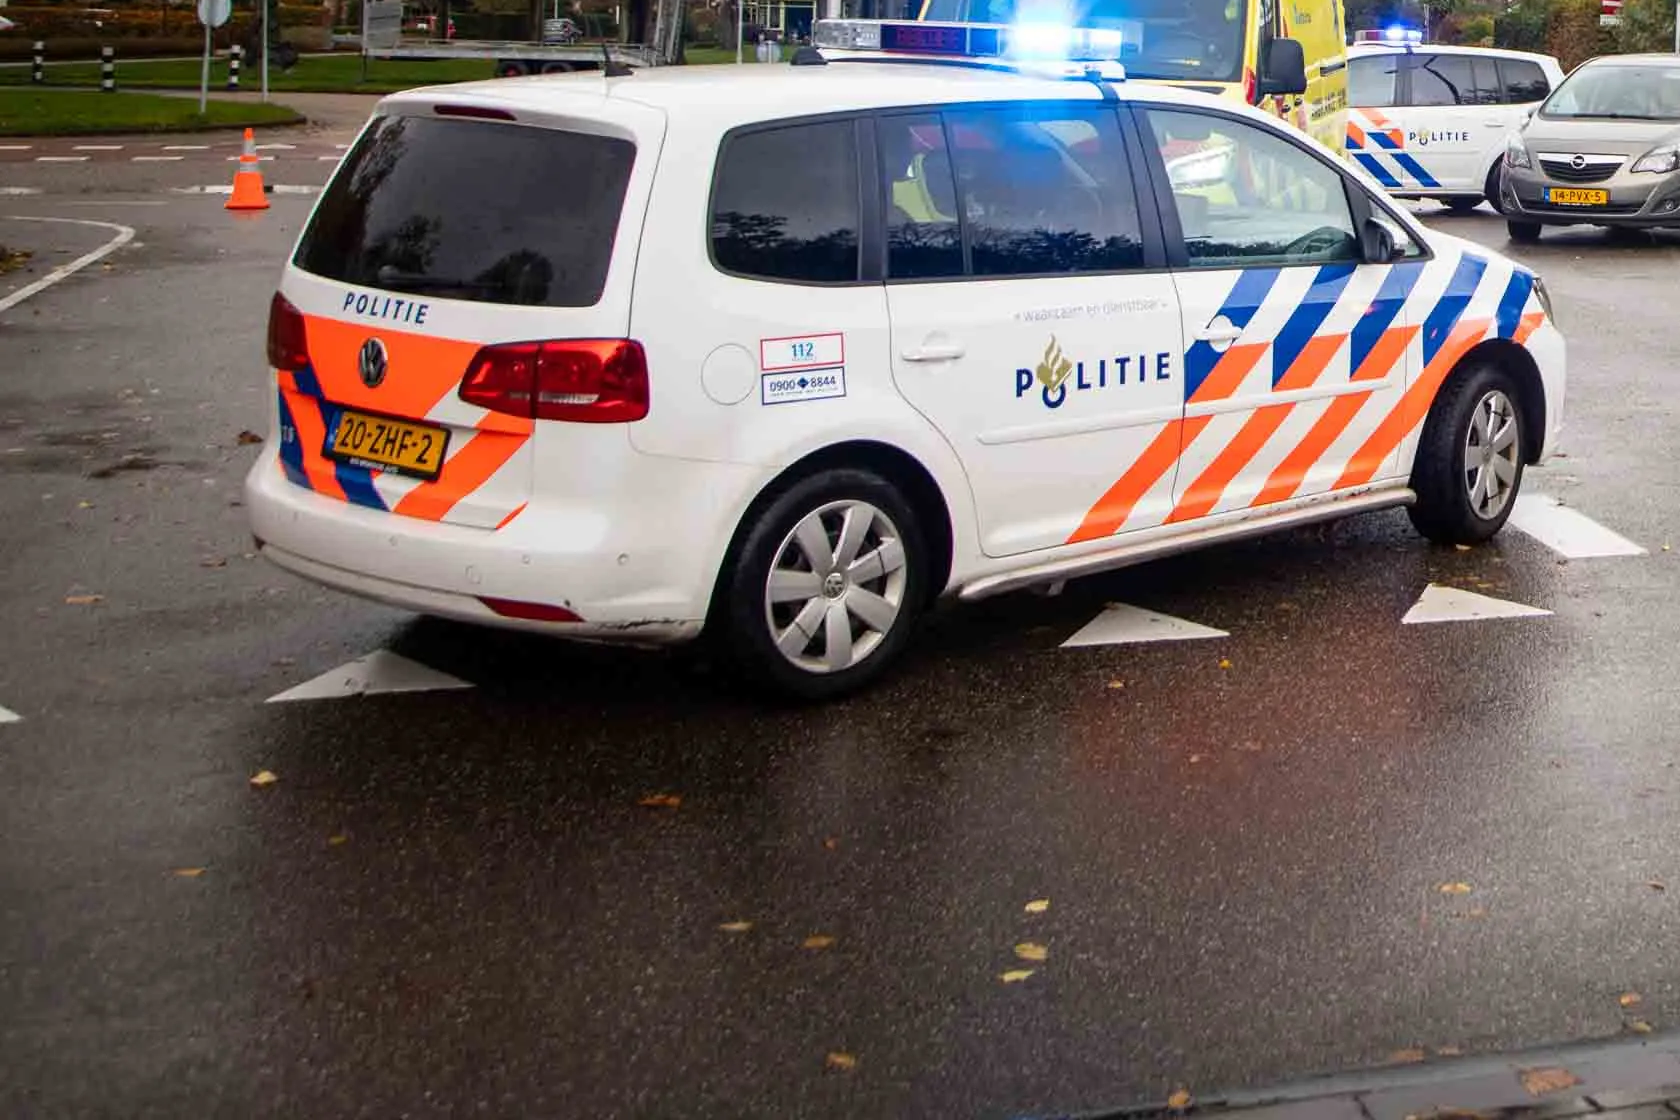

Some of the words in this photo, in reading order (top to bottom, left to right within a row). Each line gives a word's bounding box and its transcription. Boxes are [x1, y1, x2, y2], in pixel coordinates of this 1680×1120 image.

[1409, 131, 1470, 146] POLITIE
[1555, 191, 1601, 202] 14-PVX-5
[343, 291, 430, 325] POLITIE
[791, 342, 814, 358] 112
[769, 378, 796, 393] 0900
[809, 375, 837, 388] 8844
[1015, 350, 1170, 409] POLITIE
[338, 417, 434, 465] 20-ZHF-2
